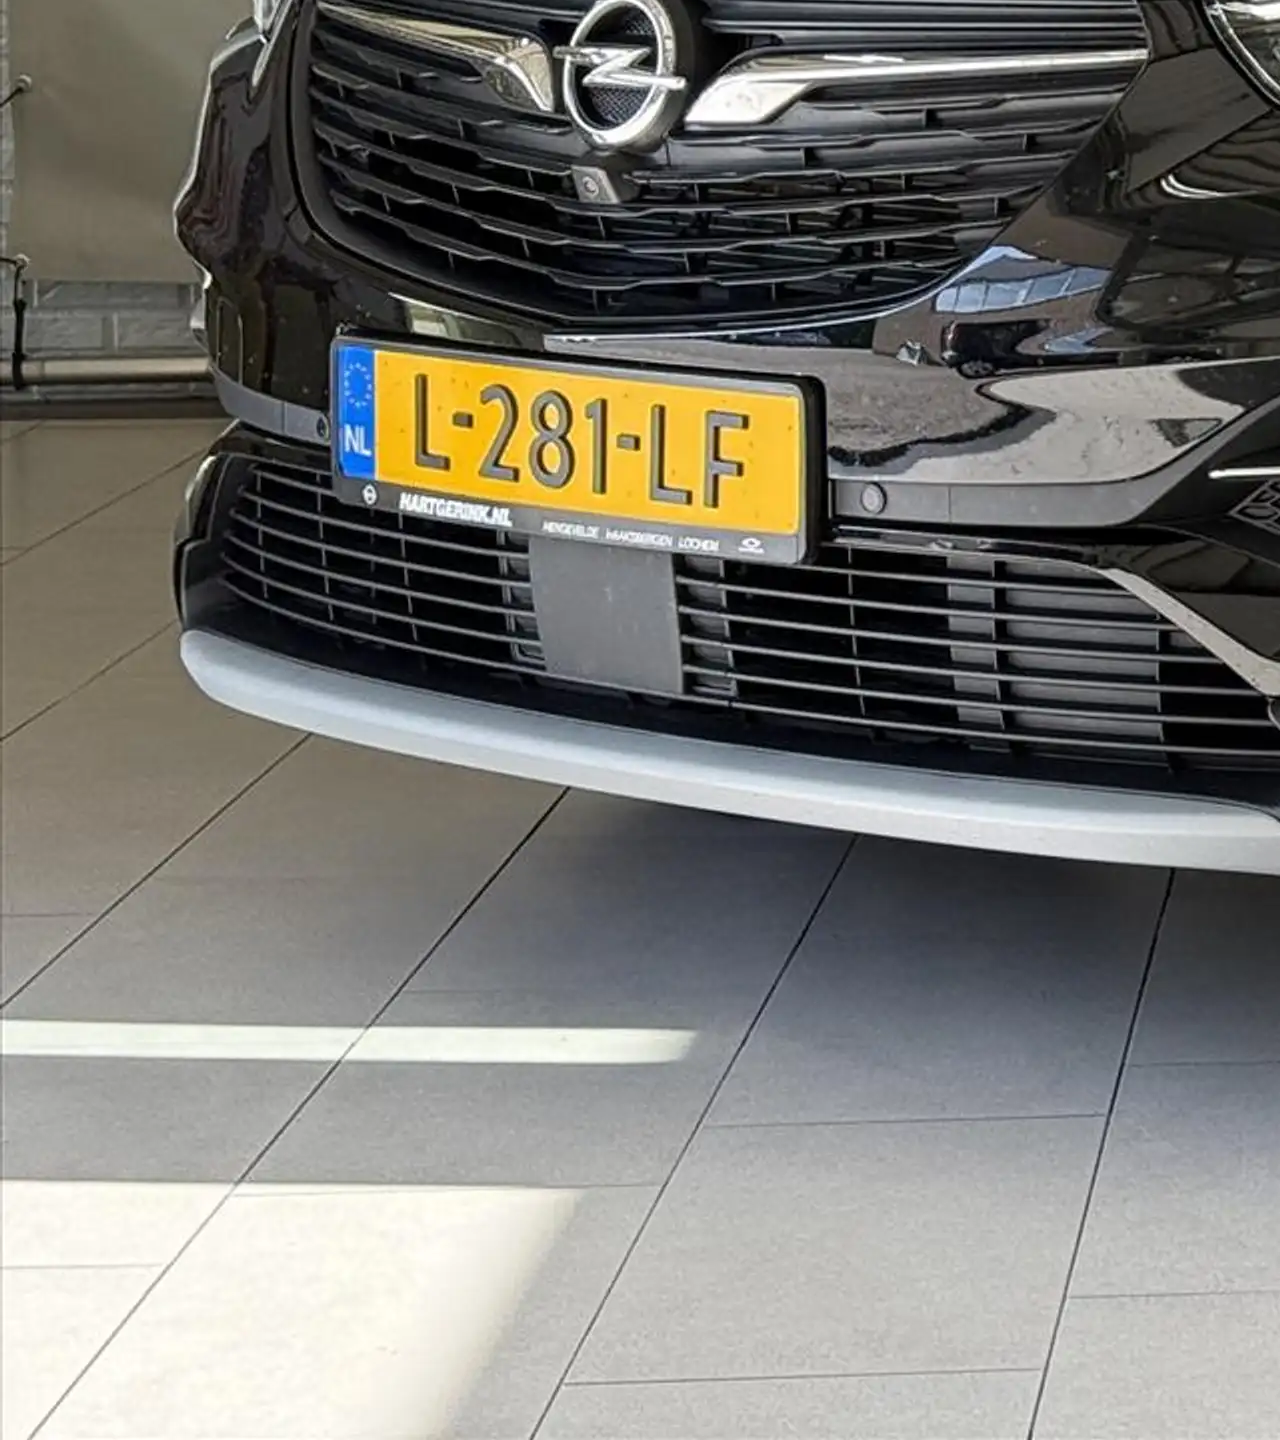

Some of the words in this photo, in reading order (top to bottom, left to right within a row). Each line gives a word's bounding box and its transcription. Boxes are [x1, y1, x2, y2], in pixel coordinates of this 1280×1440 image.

[344, 423, 372, 457] NL
[413, 372, 750, 509] L-281-LF
[400, 491, 513, 528] HARTGERINK.NL
